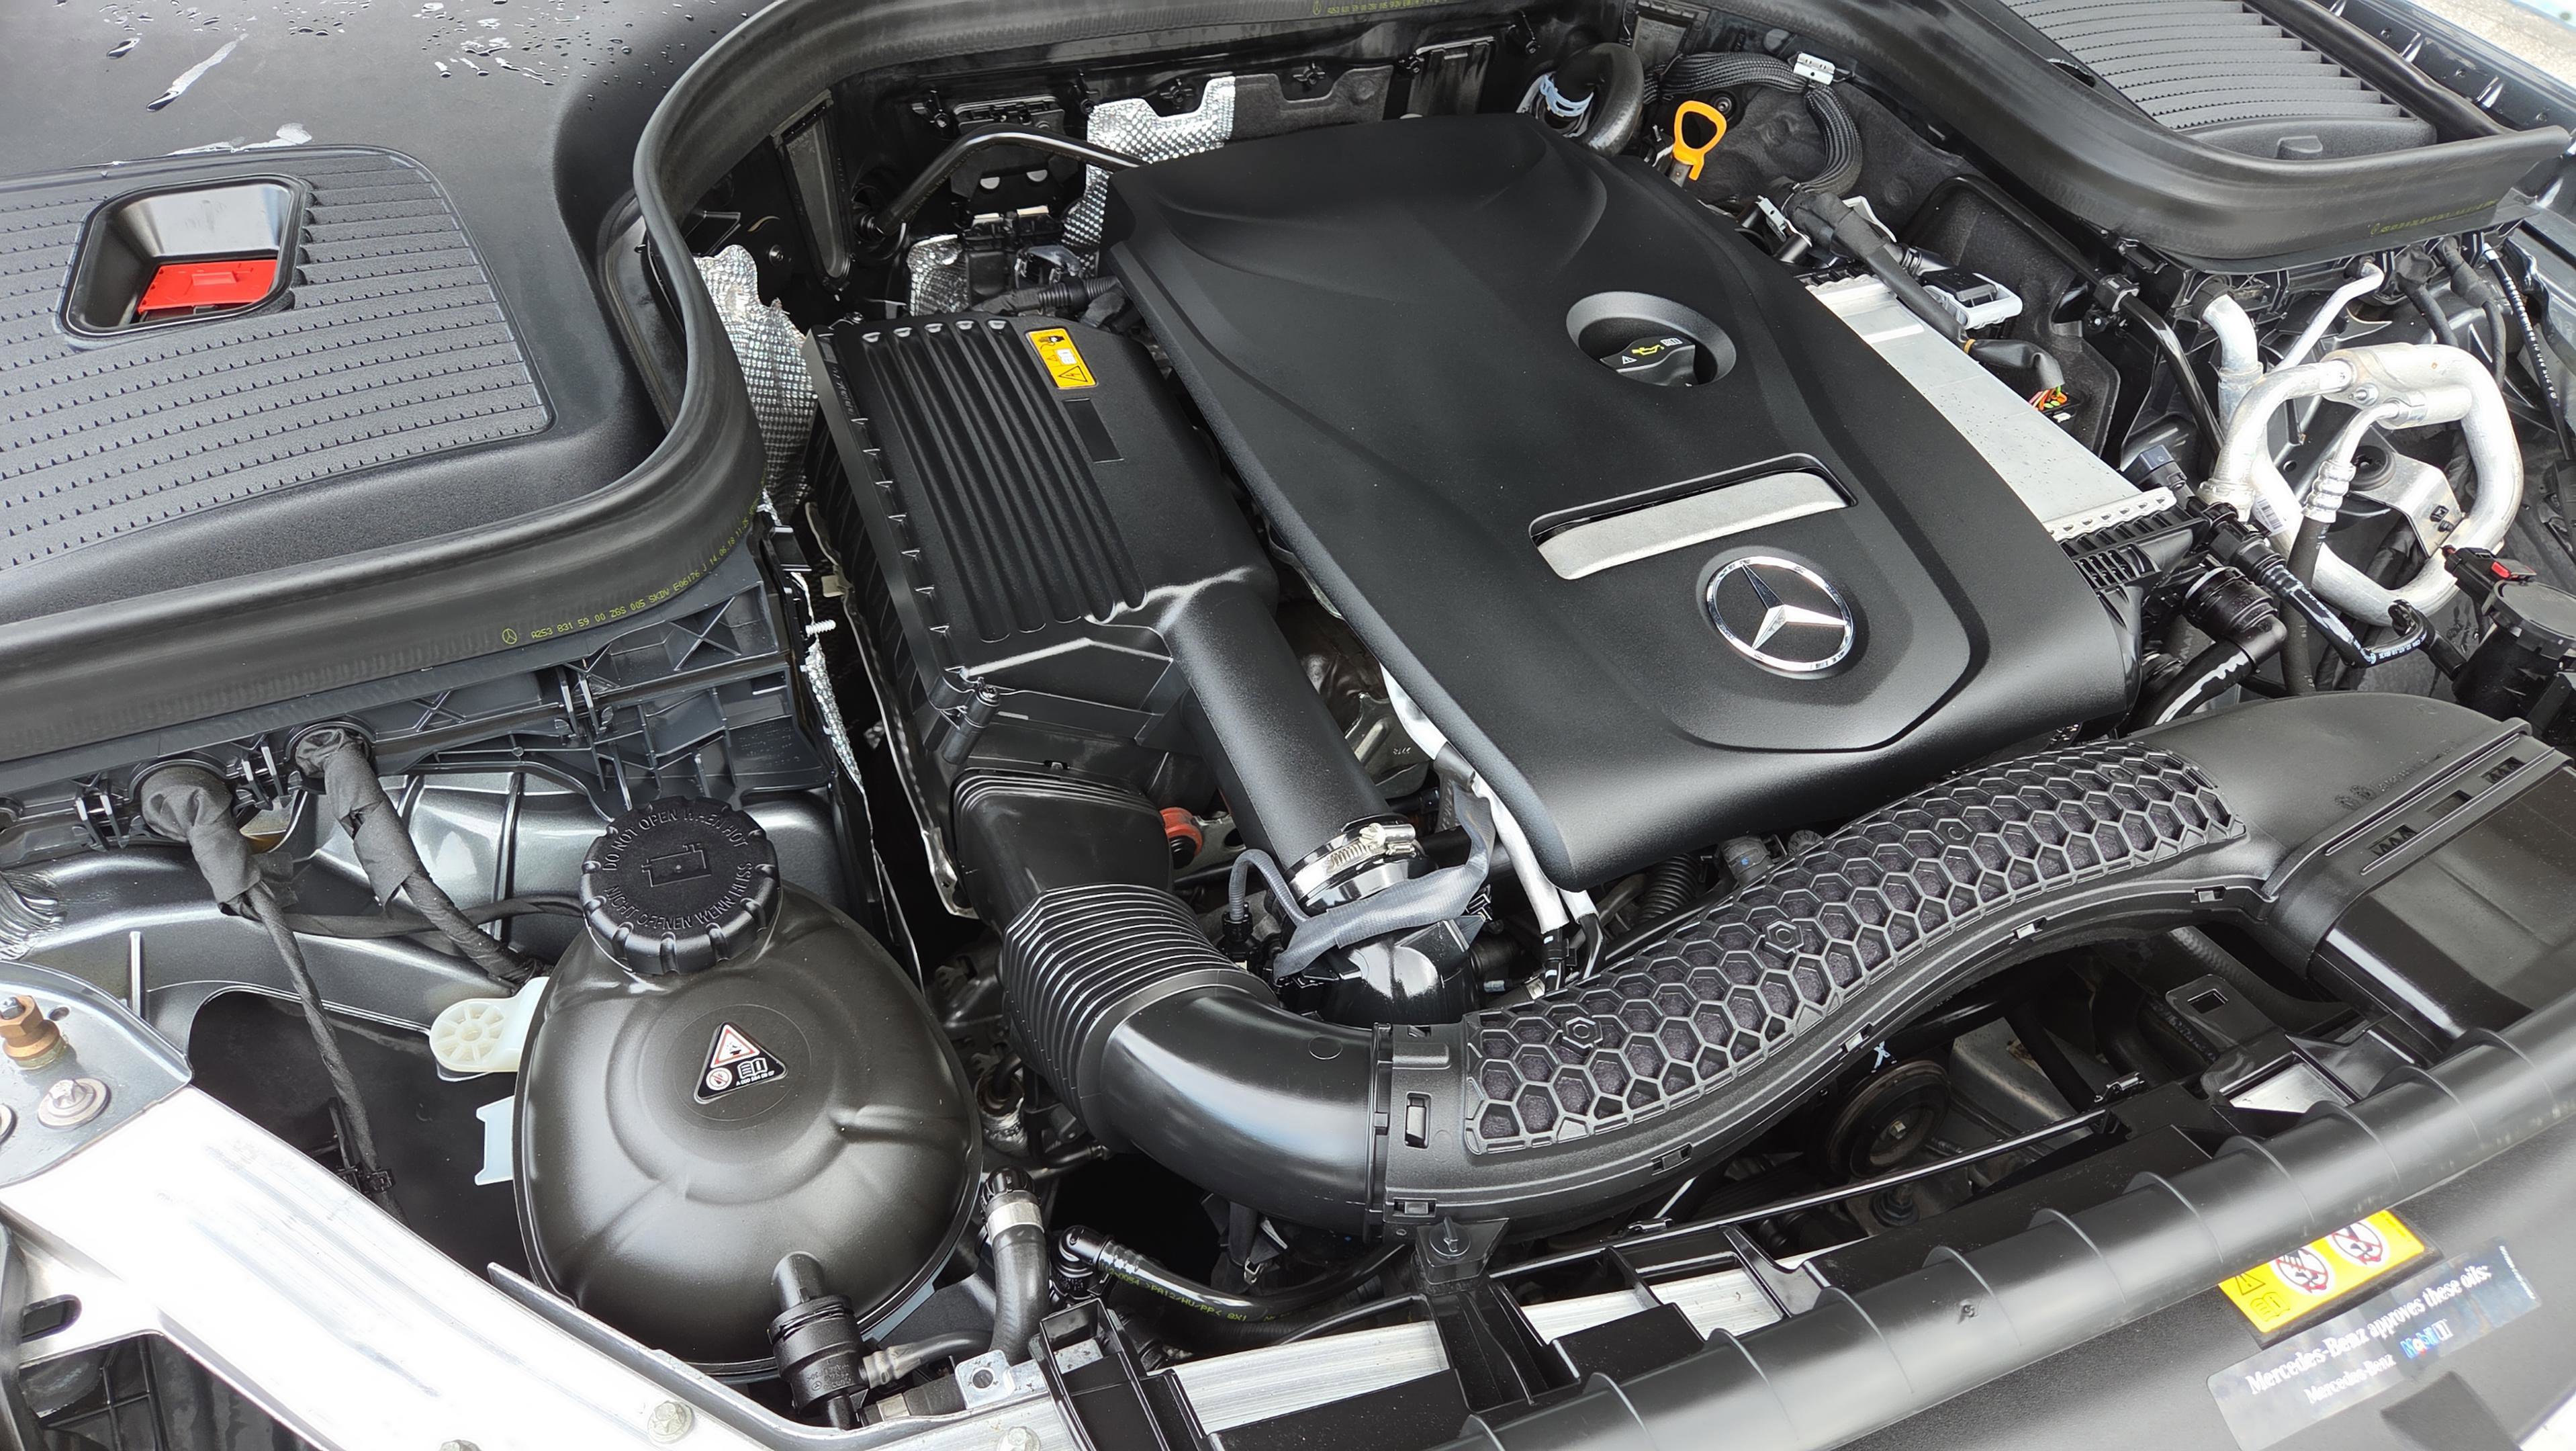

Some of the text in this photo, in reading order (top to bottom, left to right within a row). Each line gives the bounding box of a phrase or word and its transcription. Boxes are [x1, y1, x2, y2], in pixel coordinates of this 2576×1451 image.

[531, 627, 553, 640] A253
[557, 621, 573, 633] 831
[578, 617, 590, 628] 59
[594, 613, 606, 623] 00
[630, 599, 646, 611] 005
[602, 854, 620, 871] DO
[611, 827, 639, 851] NOT
[639, 809, 678, 830] OPEN
[722, 825, 749, 847] HOT
[604, 886, 639, 919] NICHT
[694, 895, 737, 924] WENN
[2244, 1327, 2371, 1396] Mercedes-Benz
[2367, 1298, 2426, 1341] approves
[2422, 1278, 2464, 1309] these
[2460, 1264, 2494, 1289] oils:
[2303, 1353, 2397, 1405] Mercedes-Benz
